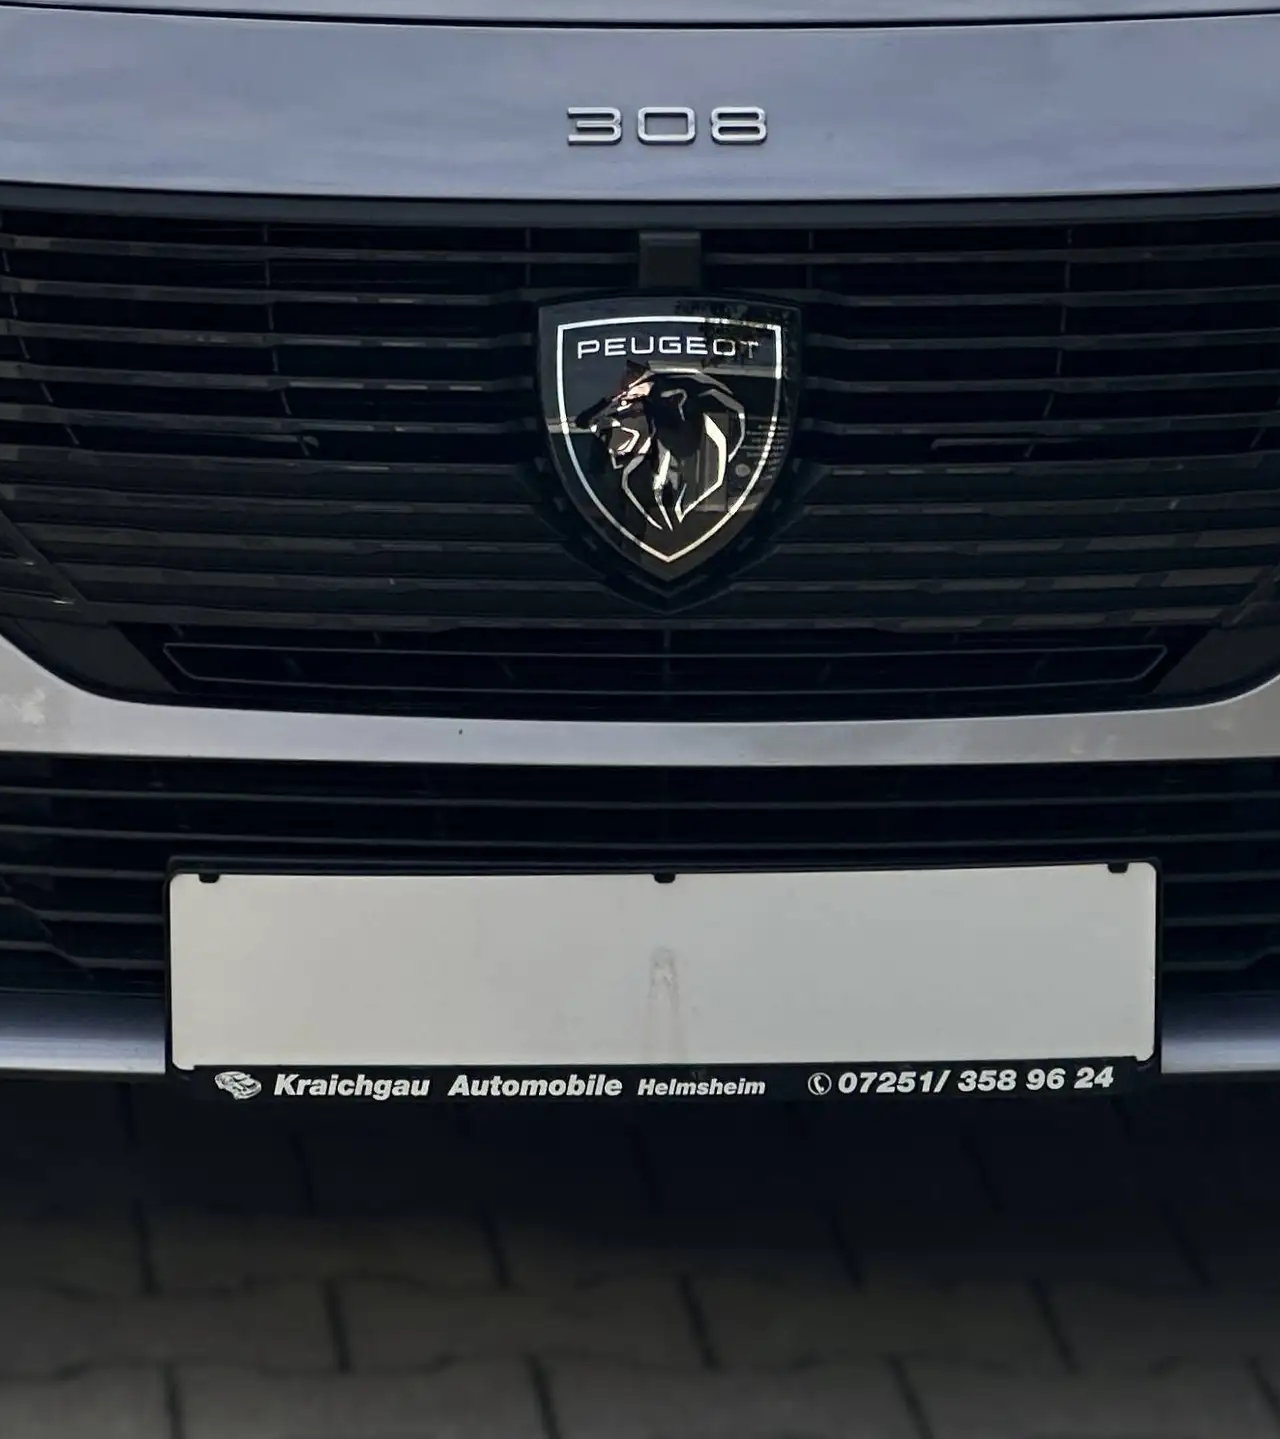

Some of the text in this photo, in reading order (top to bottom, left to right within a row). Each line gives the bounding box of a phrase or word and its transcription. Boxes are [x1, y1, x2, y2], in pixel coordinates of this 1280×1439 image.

[567, 106, 767, 145] 308
[577, 335, 760, 360] PEUGEOT
[273, 1066, 1114, 1101] Kraichgau Automobile Helmsheim 07251/ 358 96 24
